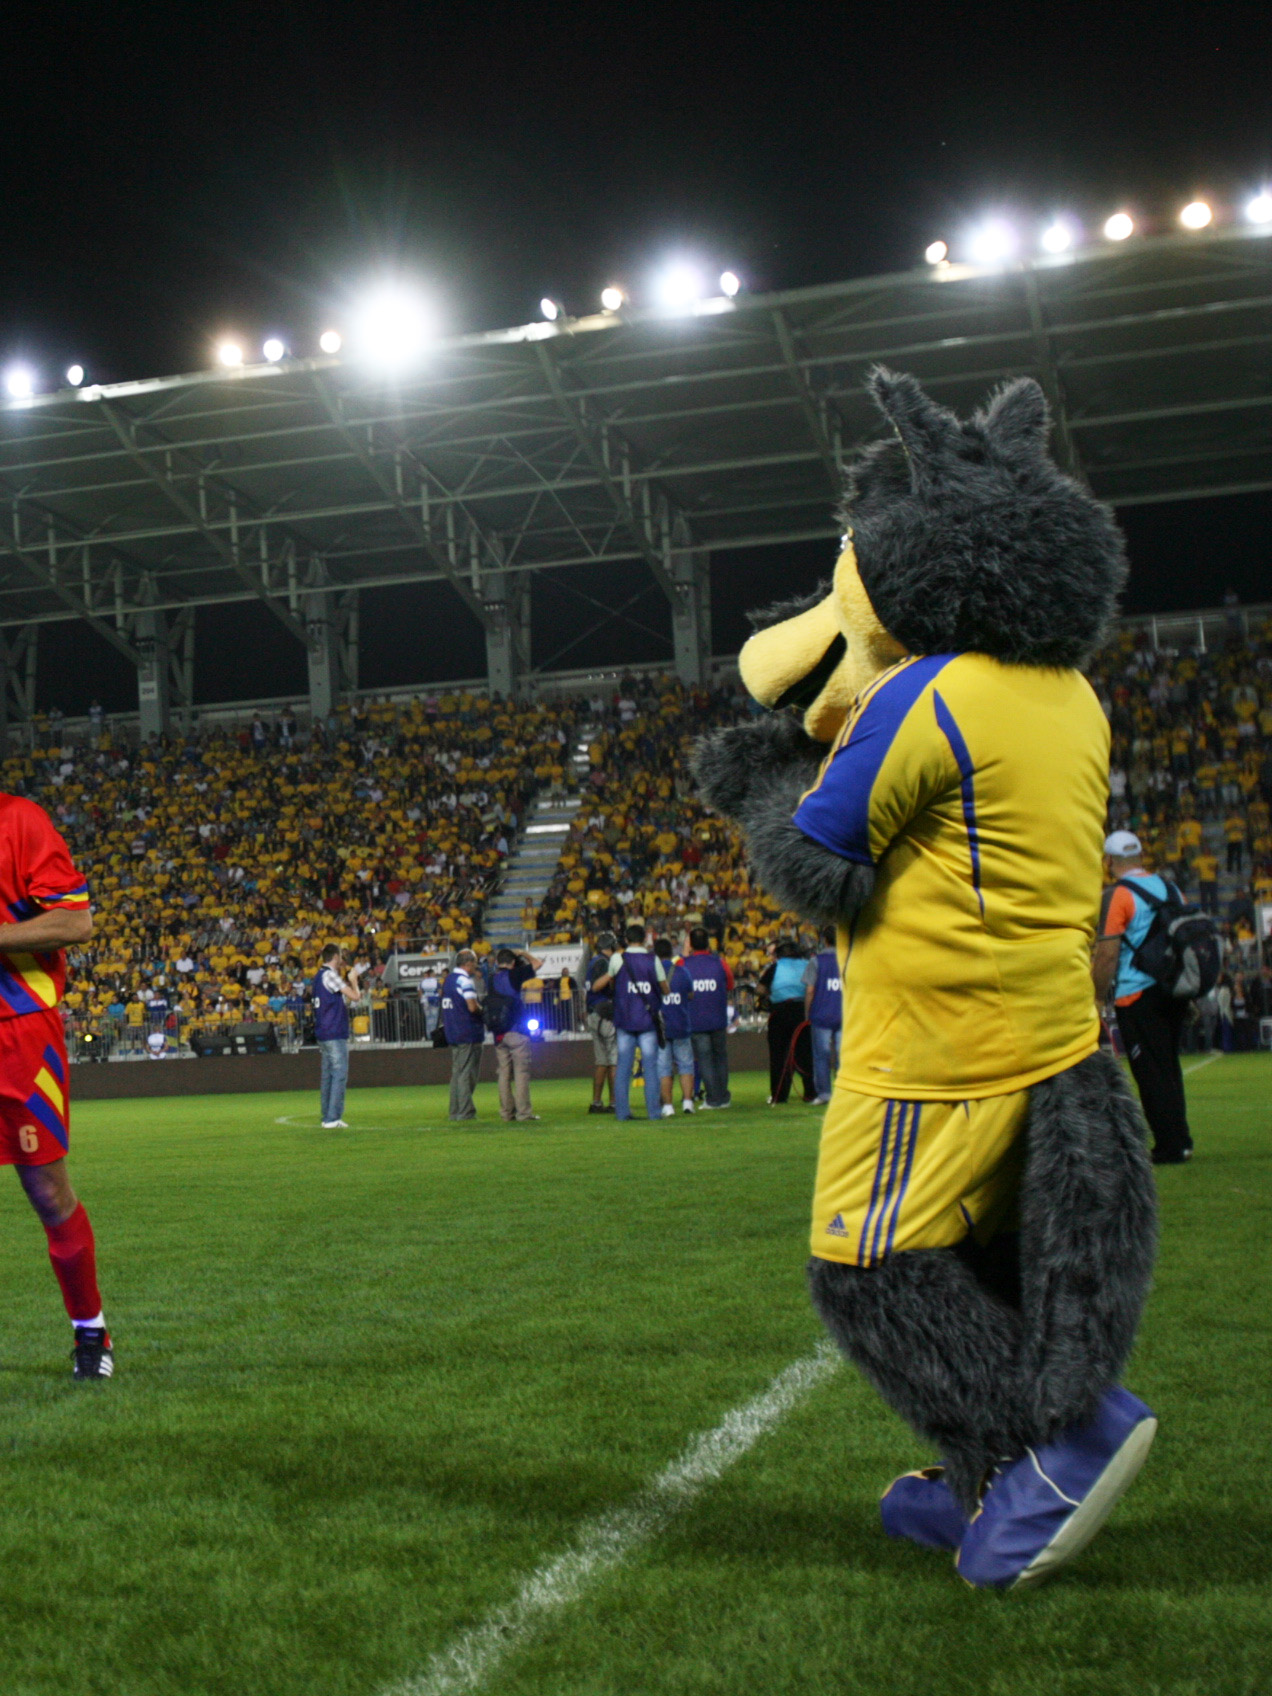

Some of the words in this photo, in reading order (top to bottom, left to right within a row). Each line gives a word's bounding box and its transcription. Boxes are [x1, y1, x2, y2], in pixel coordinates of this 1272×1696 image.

[693, 979, 717, 992] FOTO
[662, 993, 681, 1005] OTO
[19, 1124, 39, 1153] 6
